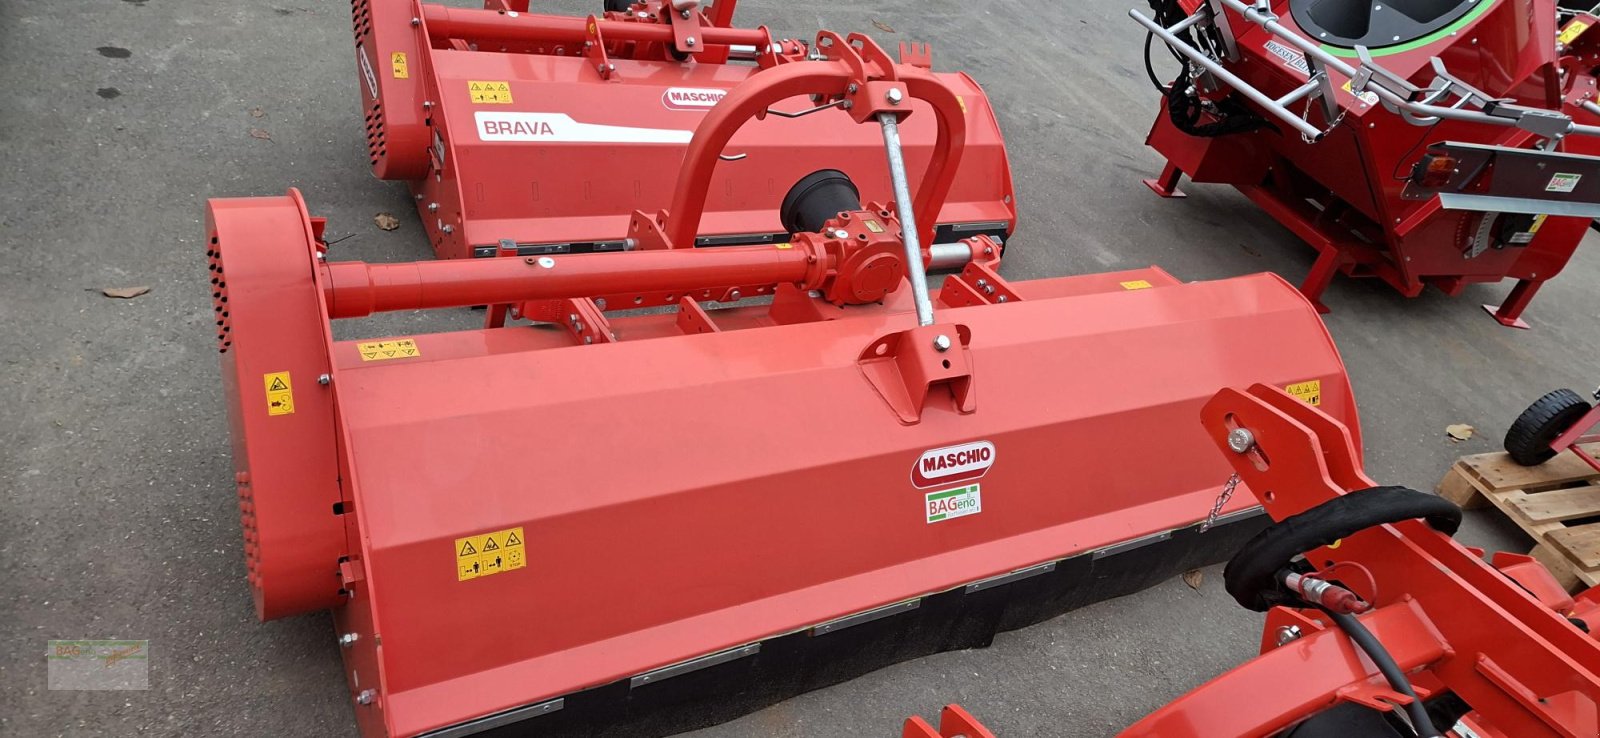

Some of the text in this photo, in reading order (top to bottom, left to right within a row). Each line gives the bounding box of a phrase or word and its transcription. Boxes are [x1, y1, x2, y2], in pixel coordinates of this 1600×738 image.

[1266, 41, 1296, 61] VOGESEN
[483, 120, 554, 136] BRAVA
[923, 447, 991, 473] MASCHIO
[929, 496, 976, 516] BAGeno
